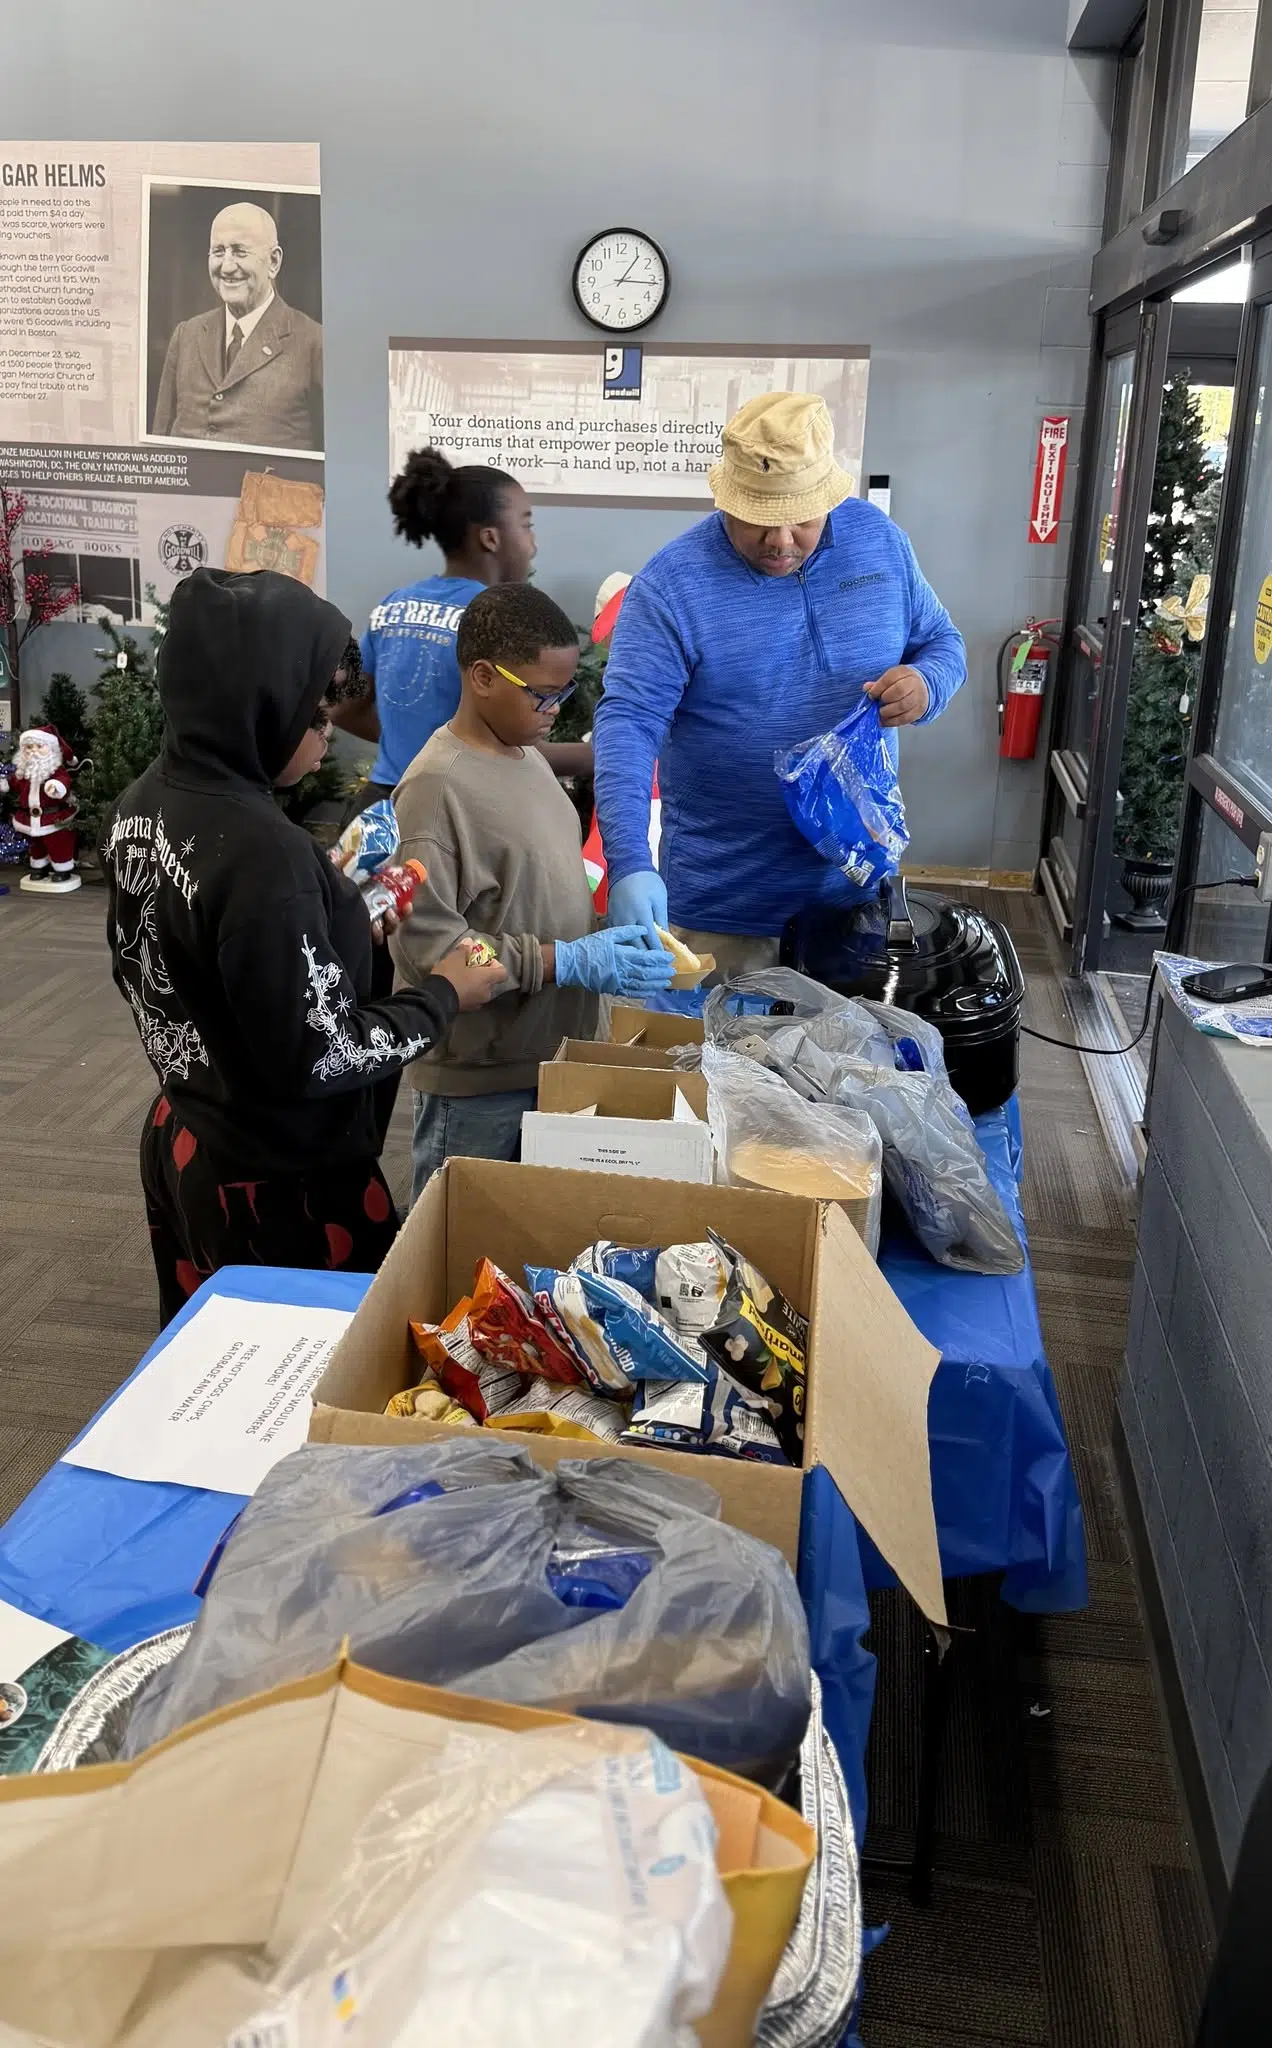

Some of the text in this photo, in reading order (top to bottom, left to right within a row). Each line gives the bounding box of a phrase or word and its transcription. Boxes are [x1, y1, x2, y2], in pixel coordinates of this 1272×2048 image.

[3, 164, 106, 187] GAR HELMS
[22, 198, 28, 206] in
[76, 199, 91, 207] this
[50, 210, 60, 218] $4
[603, 248, 611, 260] 11
[616, 242, 628, 255] 12
[636, 247, 639, 258] 1
[56, 255, 73, 263] year
[75, 254, 109, 262] Goodwill
[644, 258, 652, 270] 2
[0, 264, 22, 273] ough
[40, 264, 60, 272] term
[61, 264, 95, 272] Goodwill
[591, 260, 603, 271] 10
[80, 276, 100, 284] With
[587, 277, 596, 288] 9
[33, 286, 61, 294] Church
[63, 286, 94, 296] funding
[643, 290, 651, 302] 4
[11, 296, 19, 304] to
[21, 296, 56, 304] establish
[58, 297, 91, 305] Goodwill
[592, 292, 601, 304] 8
[0, 307, 85, 316] anizations across the
[604, 305, 611, 316] 7
[618, 308, 626, 319] 6
[634, 304, 641, 315] 5
[75, 319, 111, 329] including
[19, 328, 26, 336] in
[9, 350, 50, 358] December
[26, 361, 52, 369] people
[54, 362, 91, 371] thronged
[19, 371, 55, 379] Memorial
[56, 372, 85, 380] Church
[87, 373, 95, 381] of
[5, 382, 20, 390] pay
[40, 382, 65, 390] tribute
[67, 383, 76, 391] at
[78, 383, 89, 391] his
[604, 388, 640, 399] goodwill
[429, 414, 724, 438] Your donations and purchases directly
[1044, 428, 1065, 439] FIRE
[429, 435, 724, 457] programs that empower people throug
[20, 448, 62, 458] MEDALLION
[64, 450, 72, 458] IN
[74, 450, 102, 460] HELMS'
[103, 452, 130, 461] HONOR
[131, 453, 149, 462] WAS
[150, 453, 176, 463] ADDED
[177, 455, 188, 464] TO
[0, 459, 188, 475] WASHINGTON, DC, THE ONLY NATIONAL MONUMENT
[488, 454, 502, 467] of
[574, 456, 611, 470] hand
[616, 461, 639, 474] up,
[644, 460, 667, 471] not
[672, 462, 680, 472] a
[21, 470, 31, 479] TO
[32, 471, 52, 480] HELP
[53, 472, 84, 482] OTHERS
[84, 473, 116, 483] REALIZE
[117, 475, 123, 484] A
[124, 475, 153, 485] BETTER
[154, 476, 191, 487] AMERICA.
[1040, 444, 1057, 534] EXTINGUISHER
[24, 511, 79, 527] VOCATIONAL
[84, 541, 122, 553] BOOKS
[165, 542, 201, 561] GOODWILL
[240, 1344, 260, 1361] FREE
[265, 1336, 308, 1387] AND DONORS!
[228, 1362, 246, 1376] HOT
[168, 1342, 244, 1422] GATORADE AND WATER
[245, 1340, 327, 1435] TO THANK OUR CUSTOMERS
[260, 1366, 325, 1443] SERVICES WOULD LIKE
[186, 1400, 213, 1422] CHIPS,
